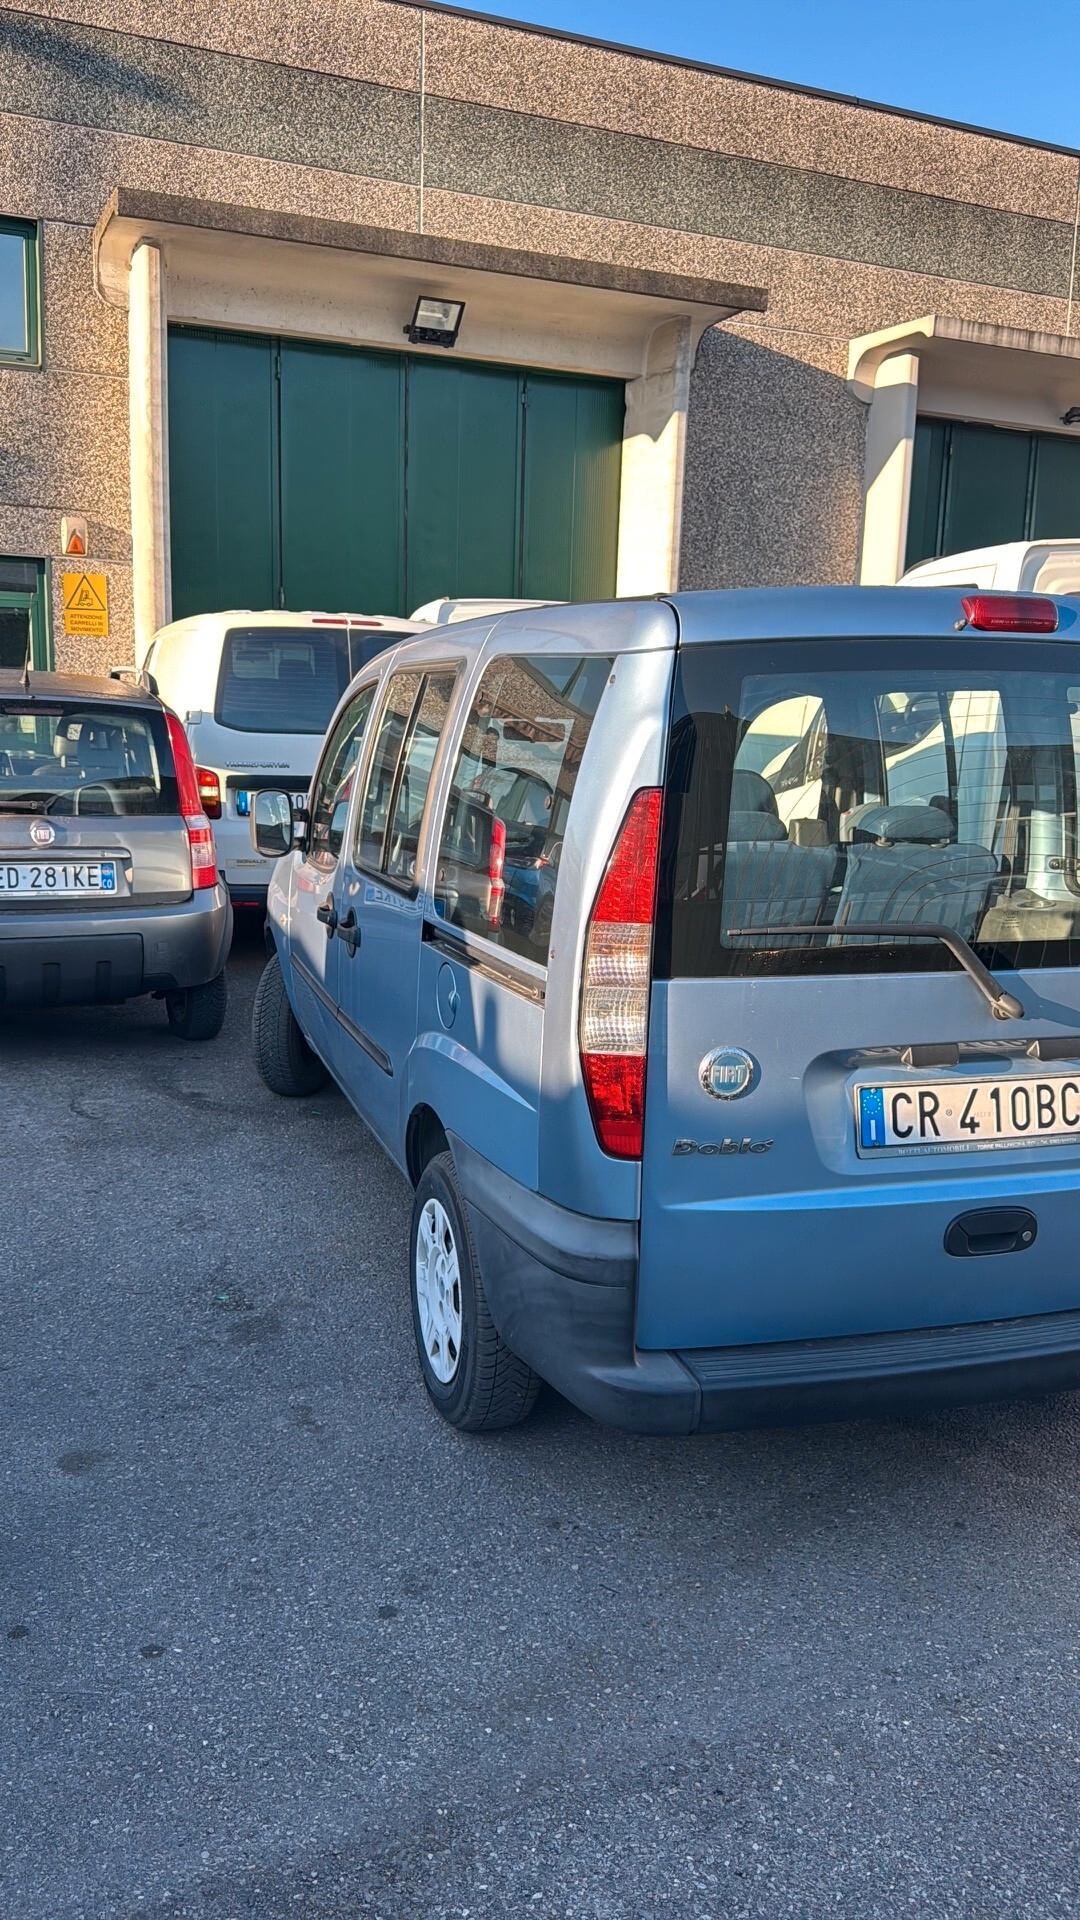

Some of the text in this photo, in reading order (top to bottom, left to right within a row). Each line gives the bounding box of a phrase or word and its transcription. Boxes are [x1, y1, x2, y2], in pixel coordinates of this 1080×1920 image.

[30, 865, 100, 888] 281KE
[102, 879, 113, 889] CO
[710, 1064, 746, 1084] FIAT
[891, 1082, 1080, 1138] CR 410BC
